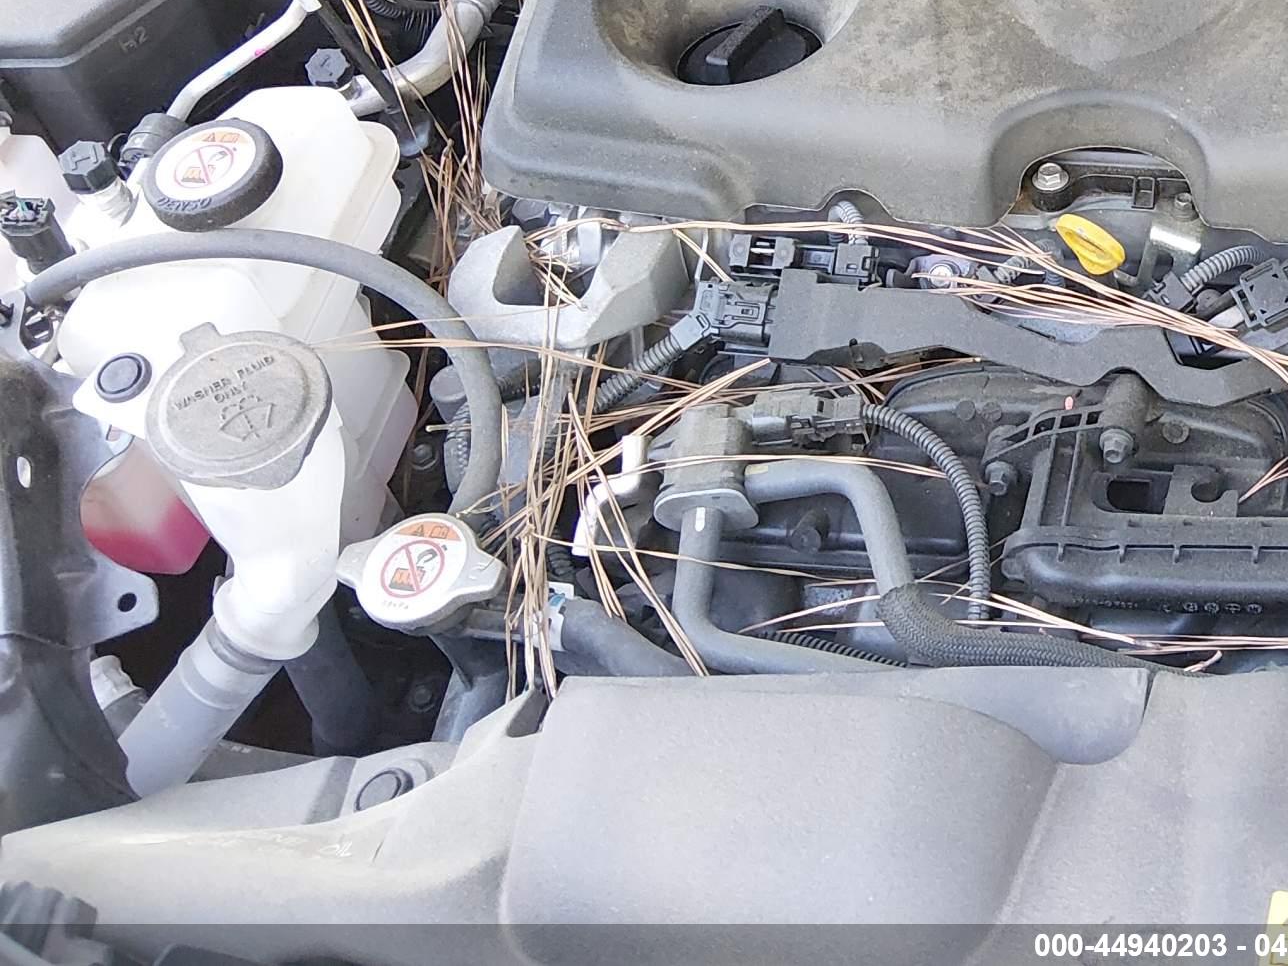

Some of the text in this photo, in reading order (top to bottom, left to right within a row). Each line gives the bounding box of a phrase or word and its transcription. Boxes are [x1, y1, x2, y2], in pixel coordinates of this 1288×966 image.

[157, 197, 212, 212] DENSO
[173, 355, 275, 411] WASHER FLUID
[213, 380, 249, 404] ONLY
